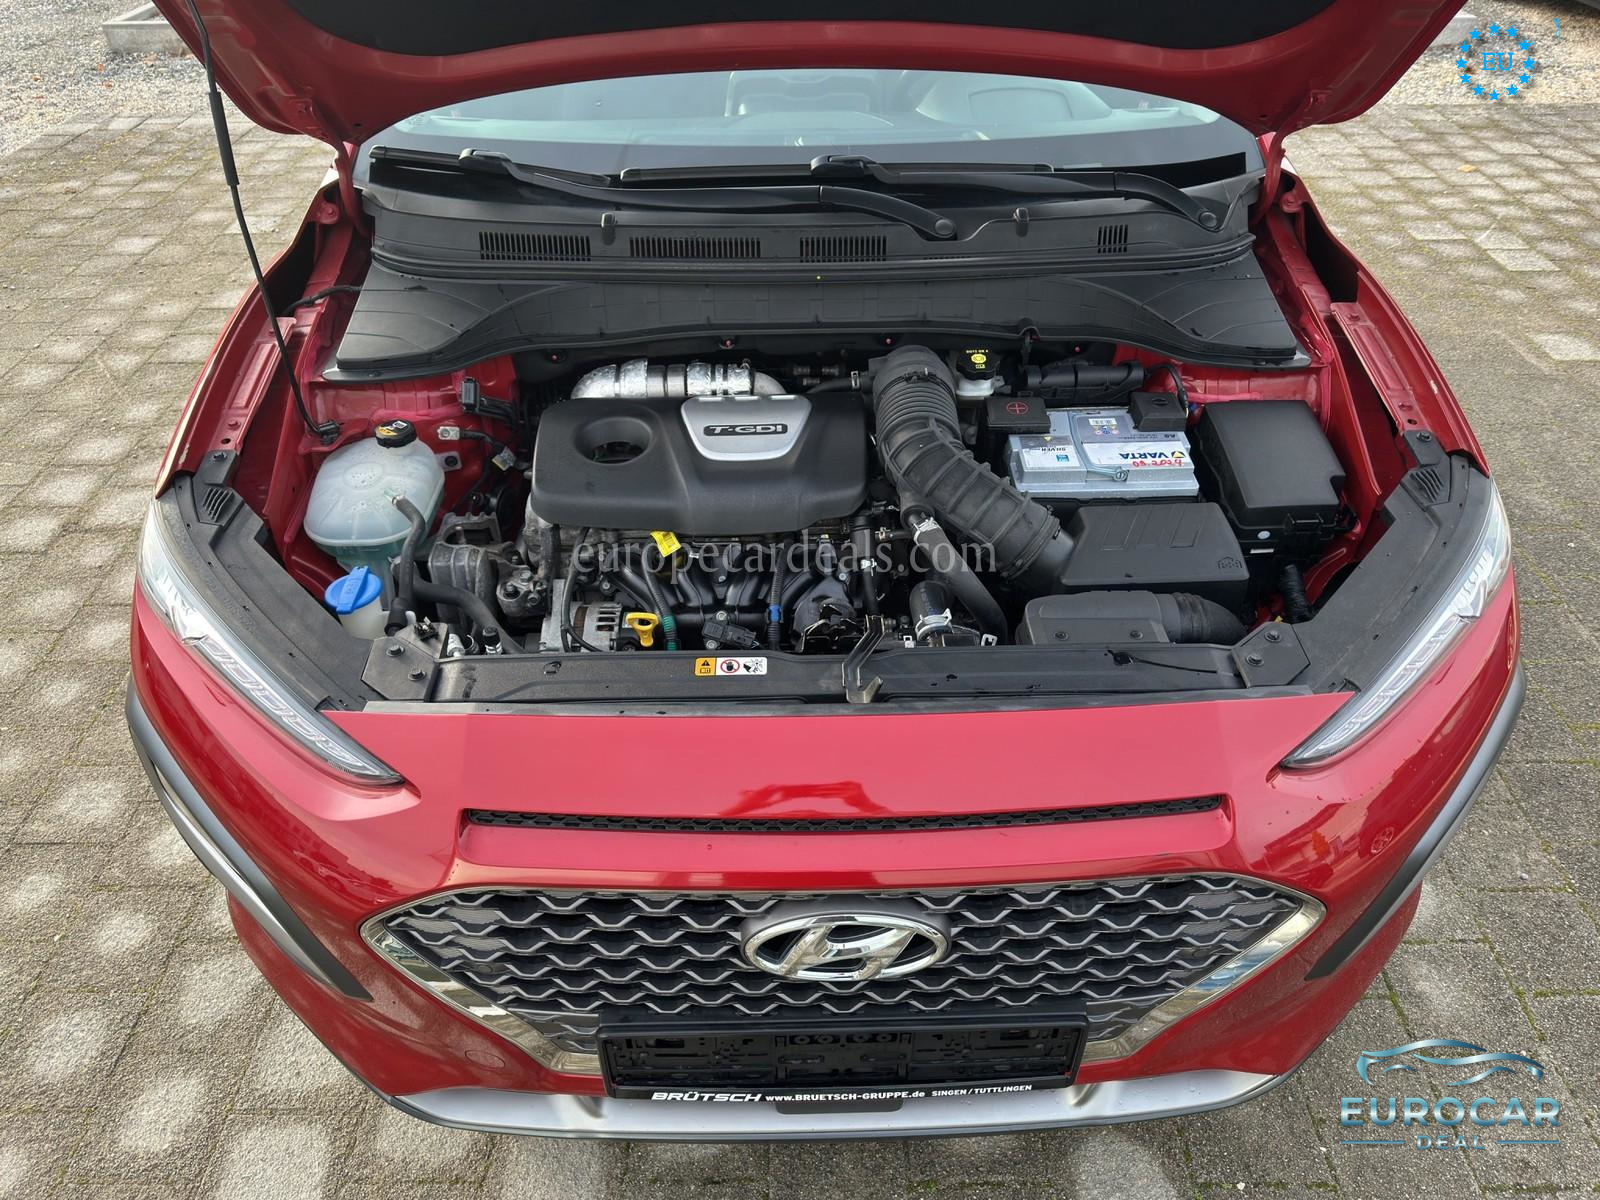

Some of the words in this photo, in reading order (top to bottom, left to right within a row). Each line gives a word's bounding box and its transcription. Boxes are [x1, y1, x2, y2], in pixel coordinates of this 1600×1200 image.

[709, 425, 783, 434] T-GDI
[1118, 451, 1169, 460] VARTA
[651, 1091, 763, 1102] BRÜTSCH
[765, 1091, 926, 1102] www.BRUETSCH-GRUPPE.de
